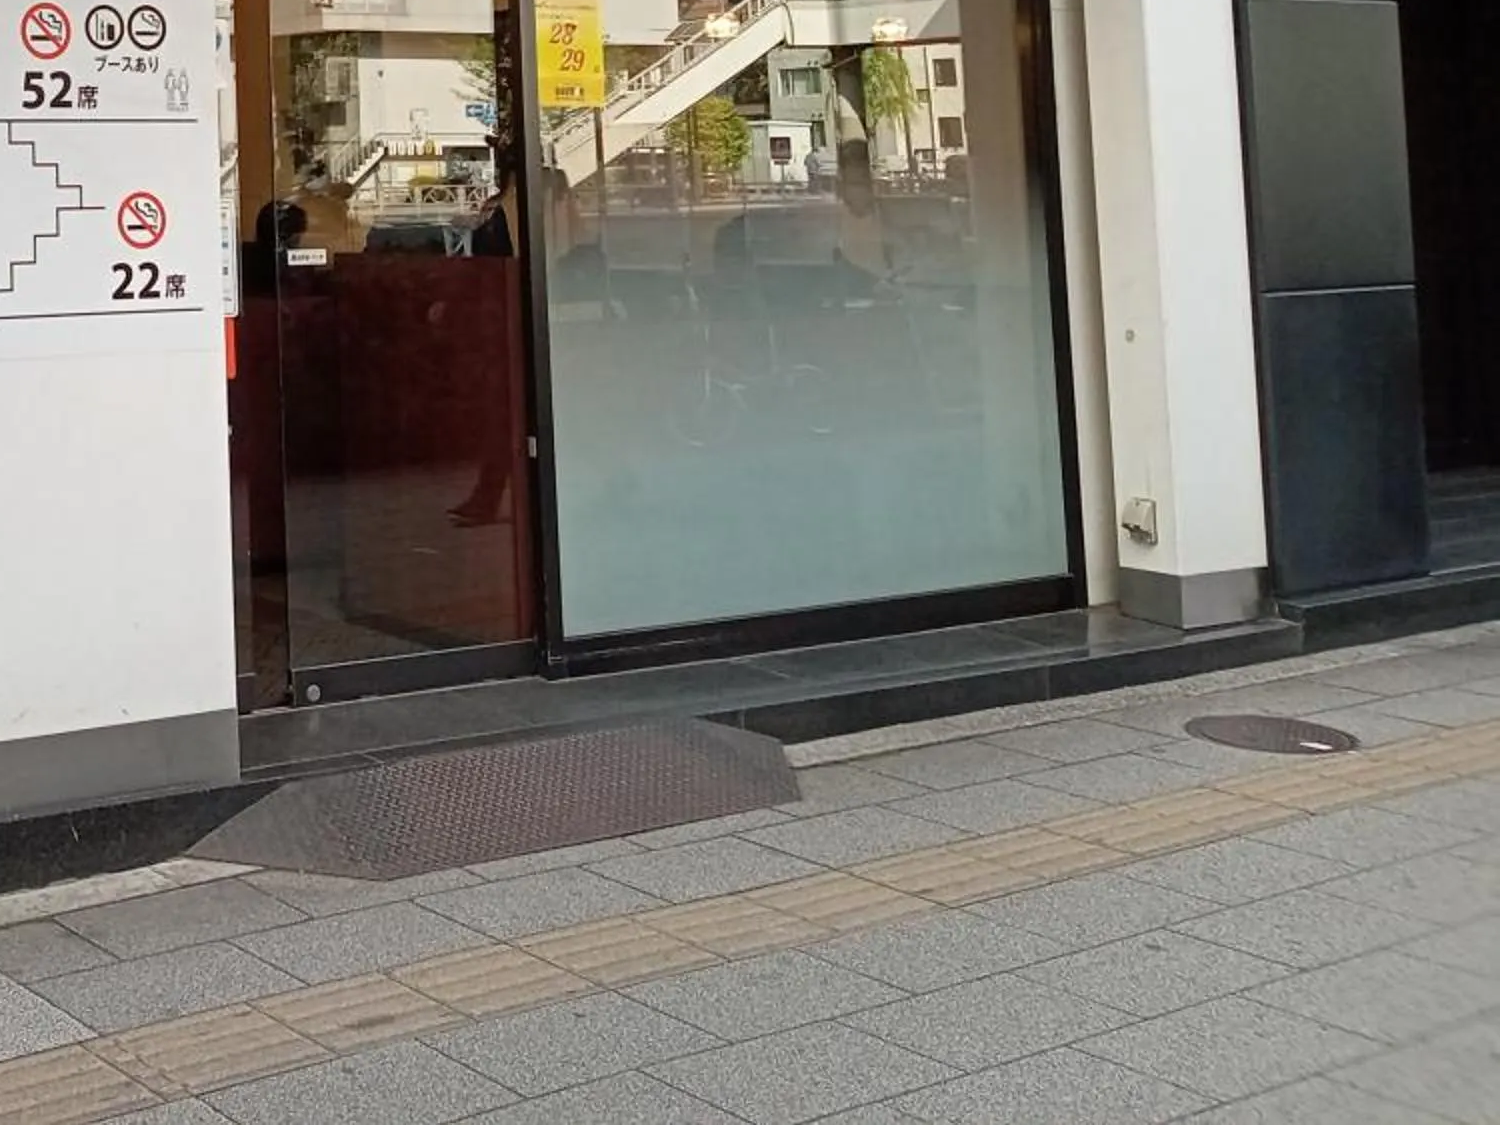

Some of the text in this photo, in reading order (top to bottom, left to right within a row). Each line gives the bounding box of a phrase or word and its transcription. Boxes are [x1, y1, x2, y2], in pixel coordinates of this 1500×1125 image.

[94, 56, 160, 73] ブースあり
[560, 48, 585, 72] 29
[21, 70, 100, 110] 52席
[111, 262, 187, 301] 22席
